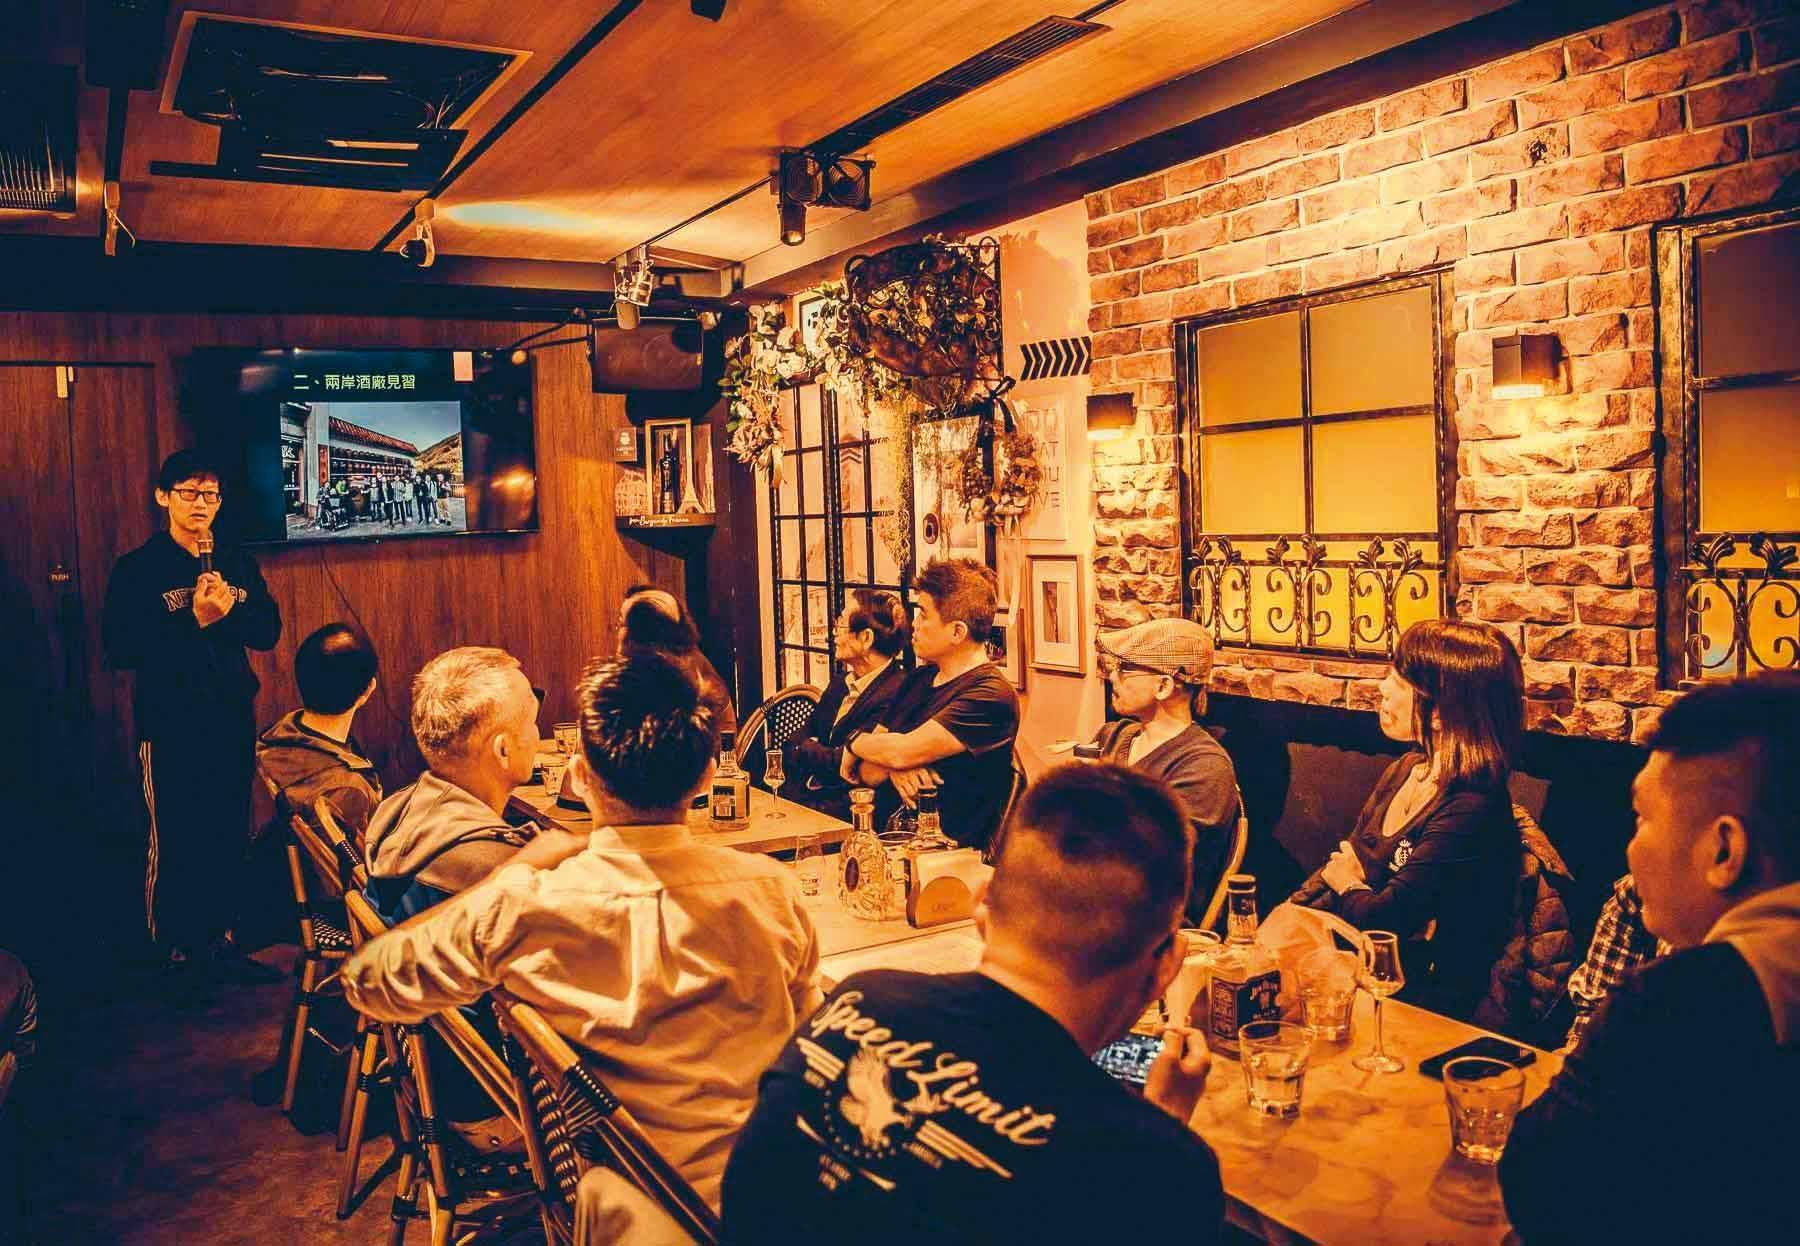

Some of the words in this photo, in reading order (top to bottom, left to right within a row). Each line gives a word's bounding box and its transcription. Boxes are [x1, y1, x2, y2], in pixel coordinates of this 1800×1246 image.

[293, 374, 416, 390] 二、兩岸酒廠見習
[810, 991, 934, 1068] Speed
[906, 1052, 1056, 1145] Limit
